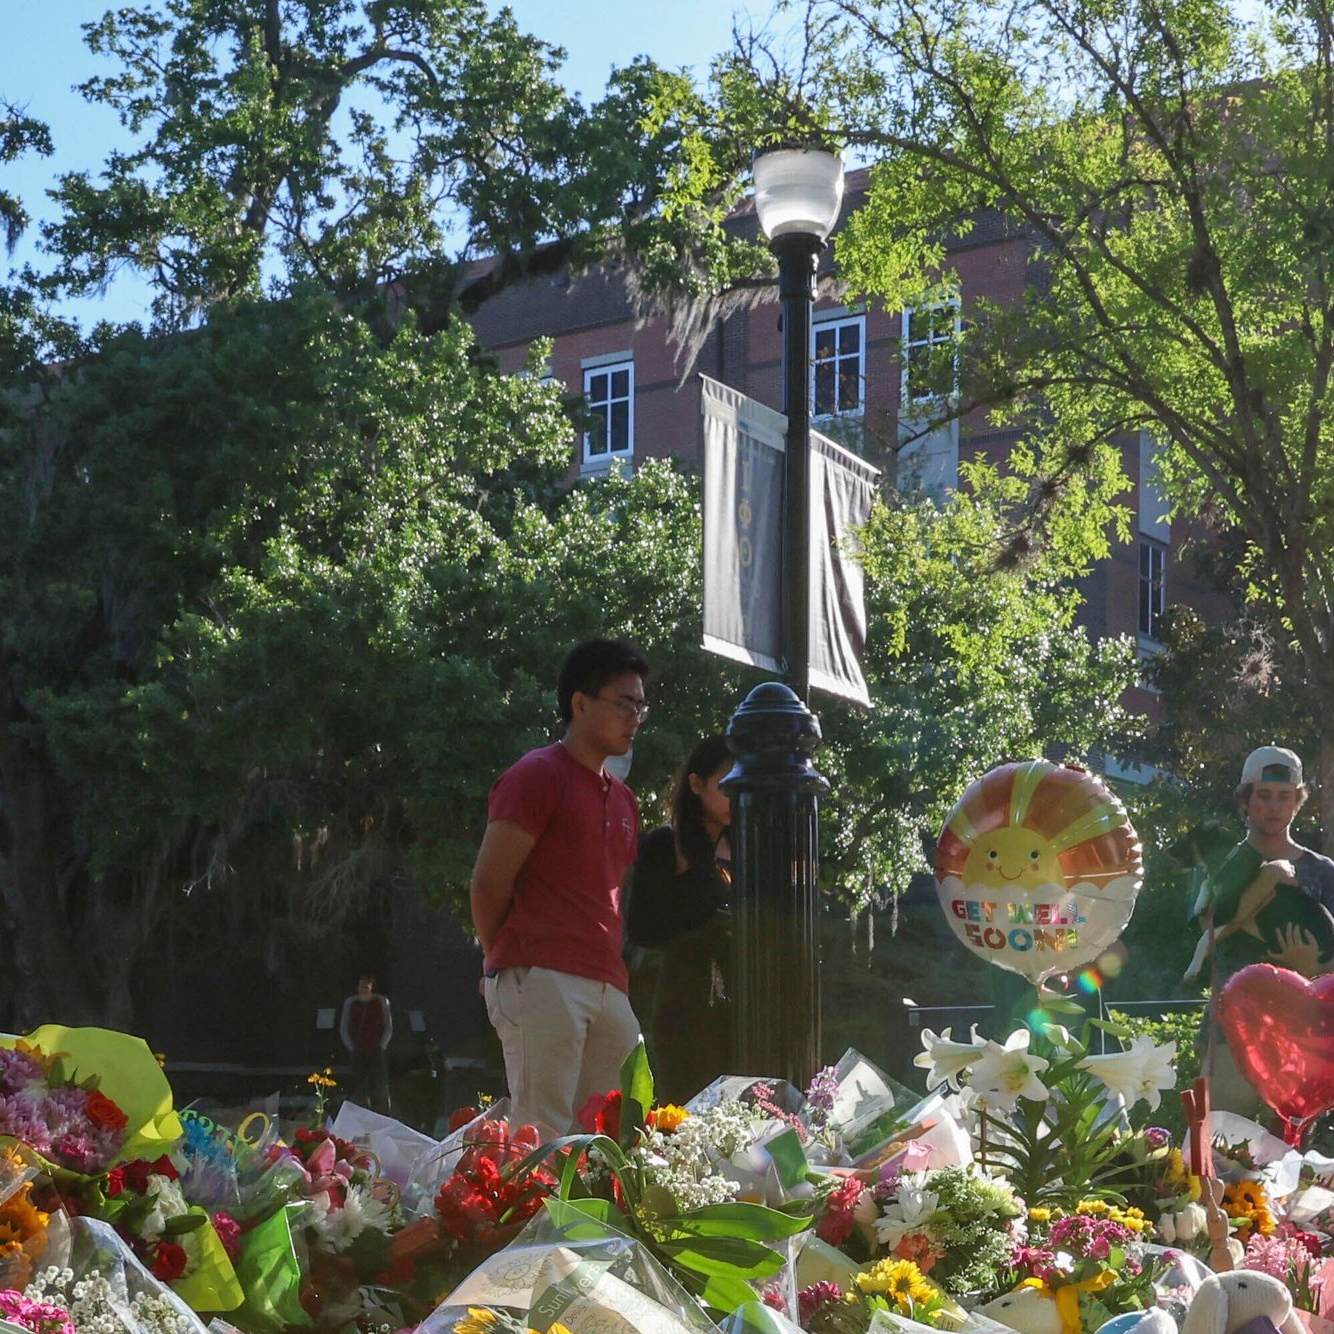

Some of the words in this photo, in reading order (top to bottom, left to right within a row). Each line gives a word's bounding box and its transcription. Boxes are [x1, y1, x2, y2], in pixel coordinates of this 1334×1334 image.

[951, 899, 997, 923] GET
[1007, 902, 1086, 925] WELL
[538, 1263, 600, 1318] Sunflwers
